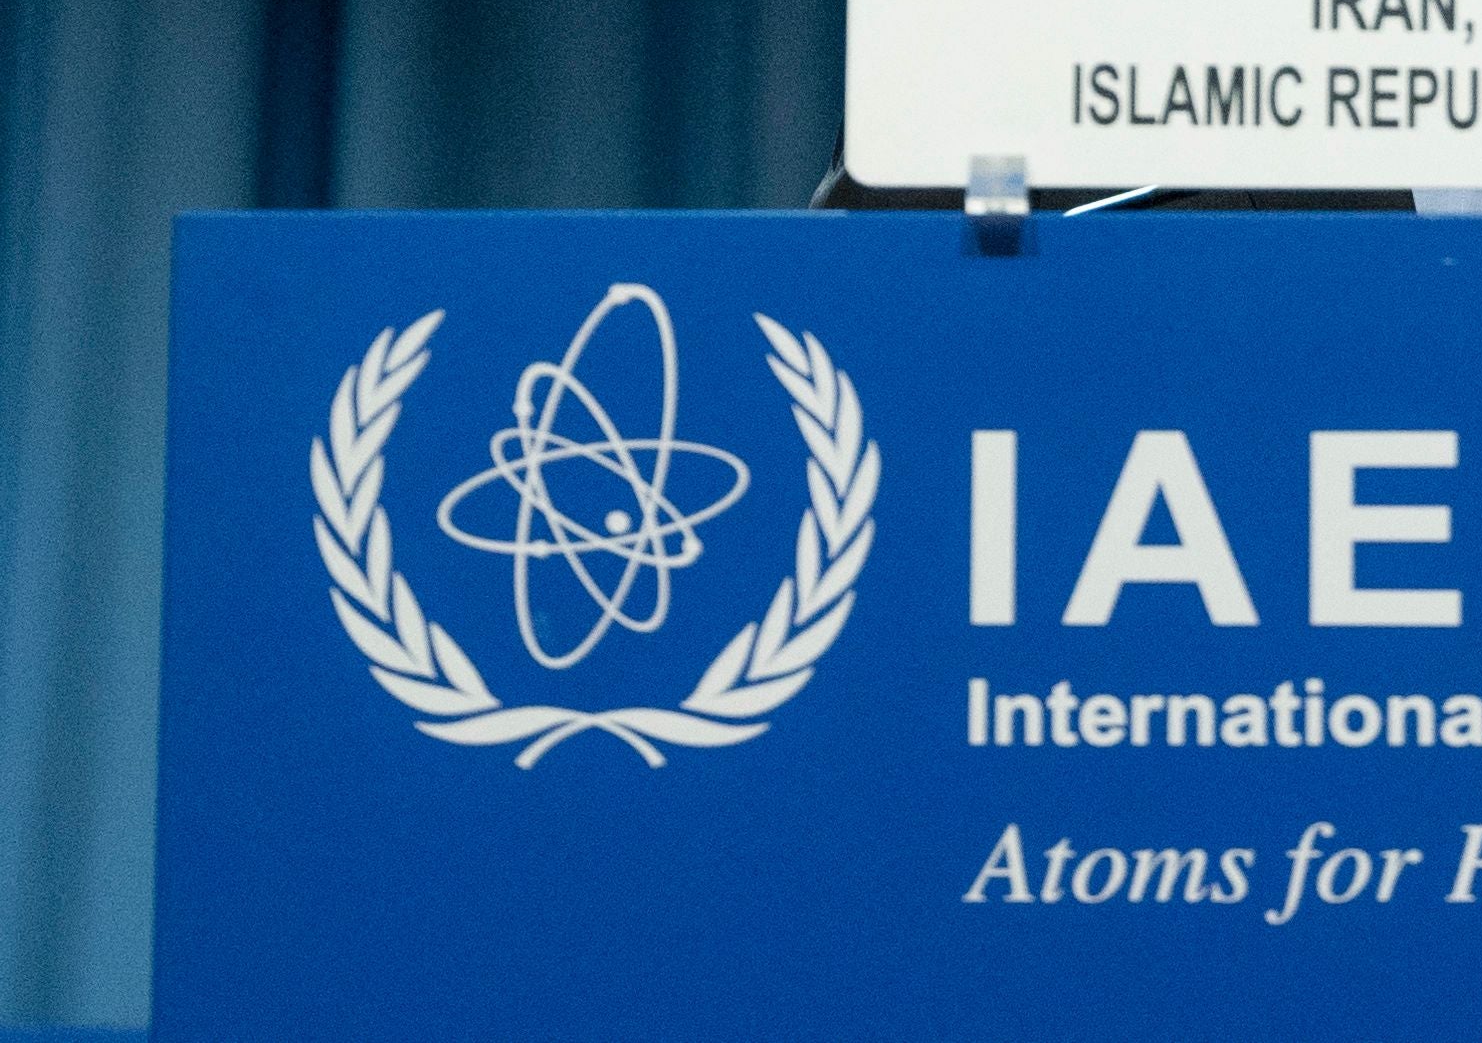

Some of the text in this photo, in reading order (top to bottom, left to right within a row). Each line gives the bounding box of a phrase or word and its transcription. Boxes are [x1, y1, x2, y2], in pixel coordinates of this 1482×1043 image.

[1072, 63, 1304, 129] ISLAMIC
[964, 823, 1252, 906] Atoms
[1265, 821, 1423, 925] for
